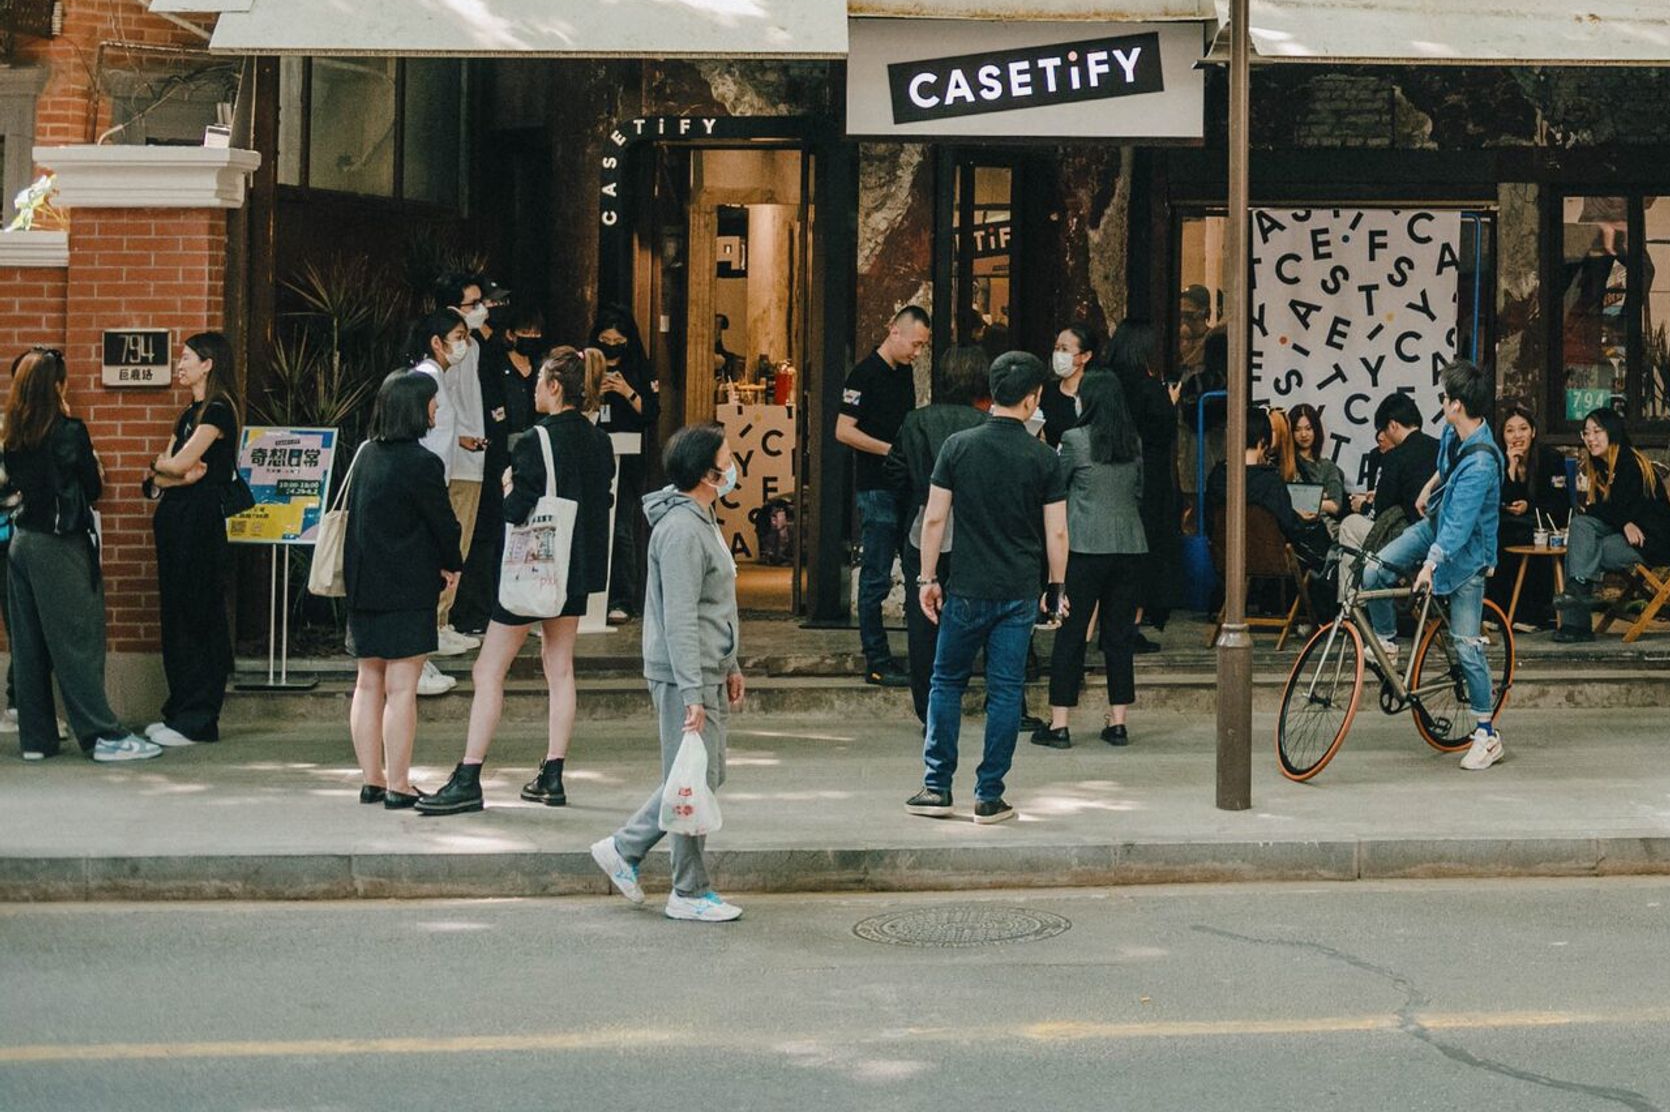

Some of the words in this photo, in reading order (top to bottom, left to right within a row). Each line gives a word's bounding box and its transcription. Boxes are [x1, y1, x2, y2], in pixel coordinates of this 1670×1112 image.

[118, 334, 156, 363] 794
[1573, 391, 1605, 408] 794
[251, 448, 321, 468] 奇想日常
